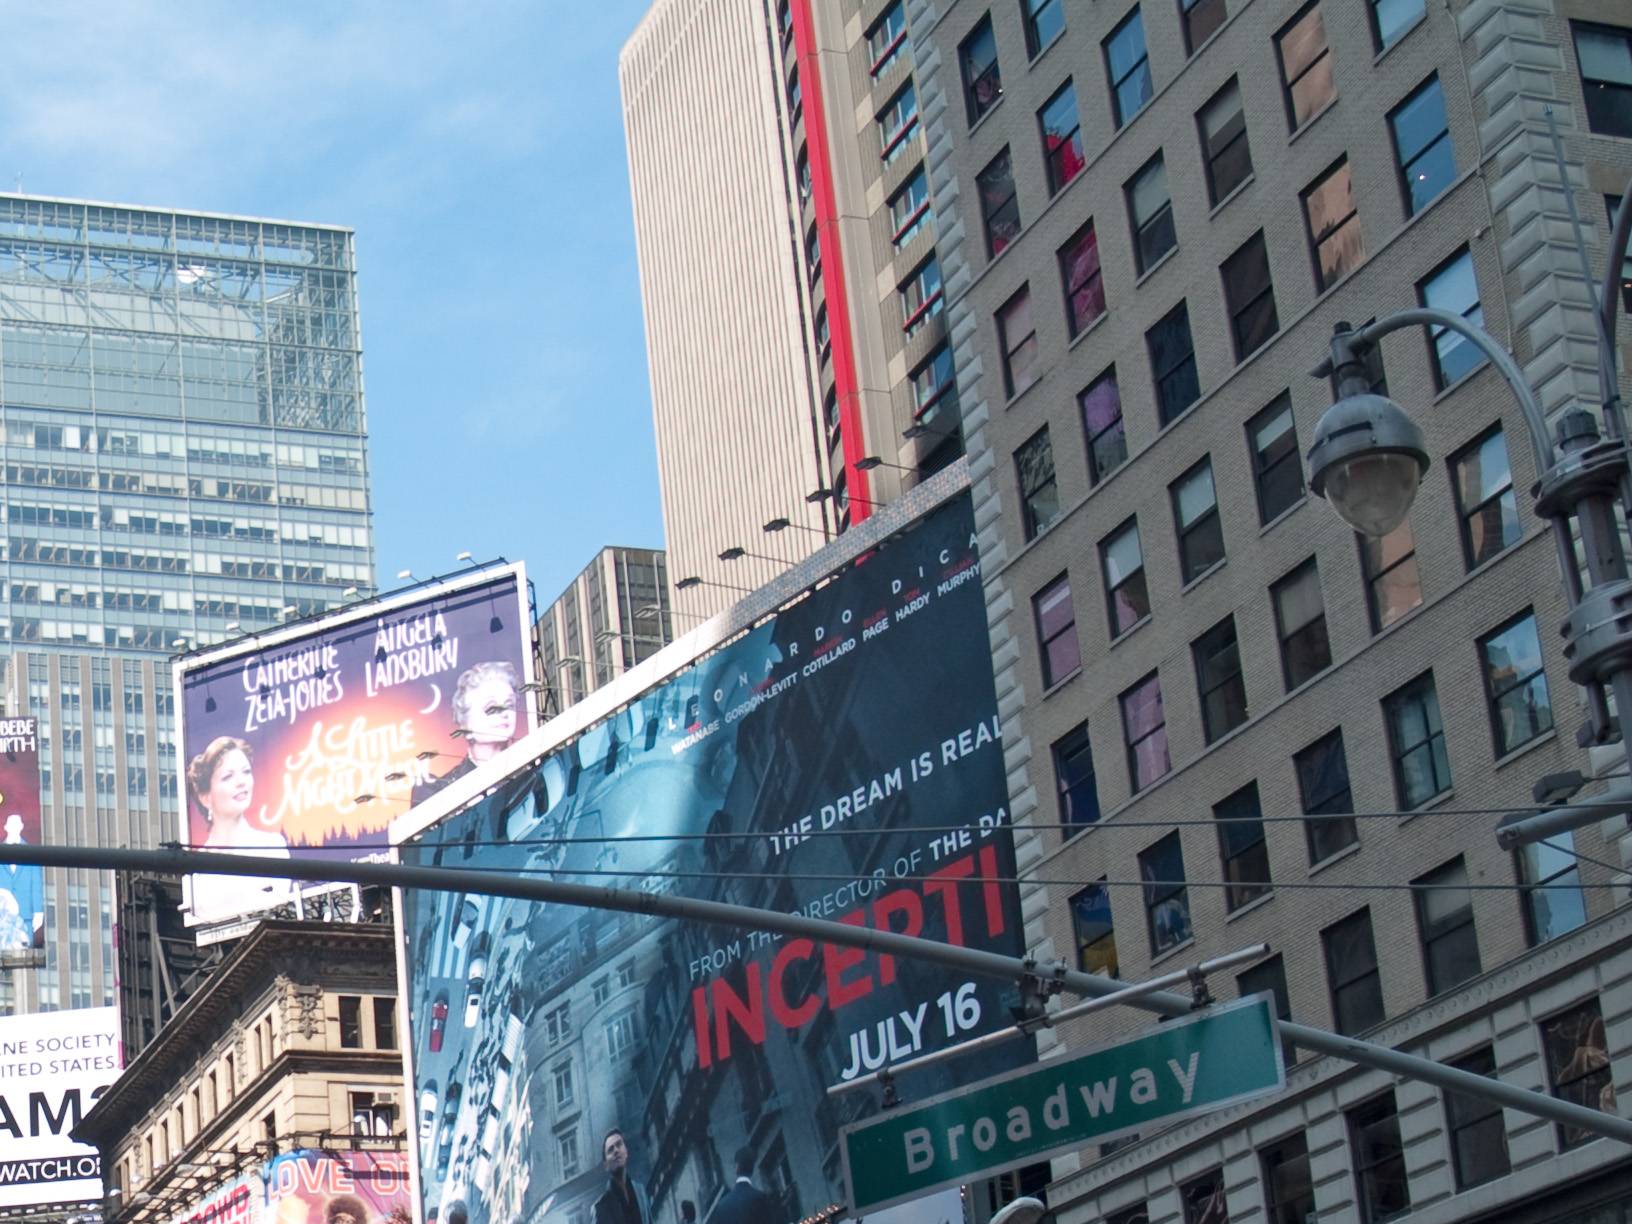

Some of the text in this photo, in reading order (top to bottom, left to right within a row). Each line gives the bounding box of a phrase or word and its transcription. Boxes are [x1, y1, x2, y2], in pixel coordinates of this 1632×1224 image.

[375, 614, 447, 655] ANGELA
[724, 671, 798, 725] GORDON-LEVITT
[802, 637, 856, 678] COTILLARD
[862, 617, 890, 643] PAGE
[895, 592, 930, 623] HARDY
[937, 562, 981, 597] MURPHY
[243, 642, 339, 694] CATHERINE
[366, 638, 458, 697] LANSBURY
[0, 719, 35, 737] BEBE
[245, 671, 343, 732] ZETA-JONES
[769, 715, 1002, 855] THE DREAM IS REAL
[689, 943, 742, 982] FROM
[788, 867, 886, 921] DIRECTOR
[893, 849, 921, 879] OF
[929, 824, 972, 861] THE
[692, 845, 1005, 1070] INCEPTI
[36, 1033, 115, 1053] SOCIETY
[842, 982, 981, 1081] JULY 16
[49, 1055, 115, 1075] STATES
[904, 1052, 1200, 1174] Broadway
[270, 1158, 354, 1198] LOVE
